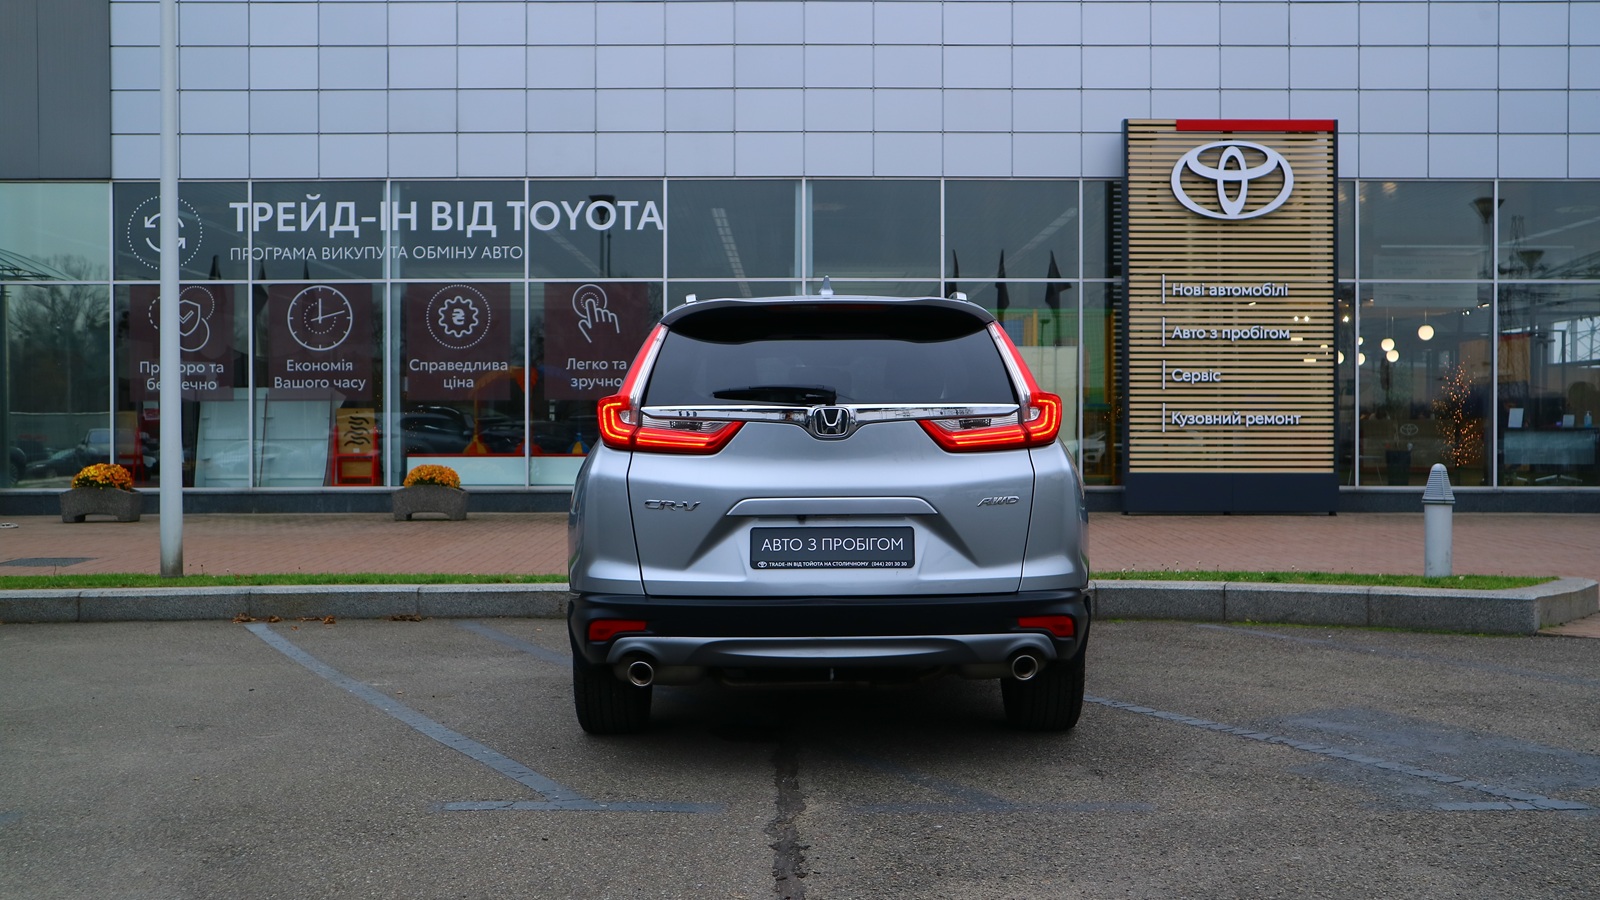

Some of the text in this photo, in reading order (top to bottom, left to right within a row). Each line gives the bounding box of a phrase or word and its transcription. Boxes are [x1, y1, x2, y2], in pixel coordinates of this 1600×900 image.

[229, 193, 665, 239] ТРЕЙД-ІН ВІД TOYOTA
[229, 244, 524, 261] ПРОГРАМА ВИКУПУ ТА ОБМІНУ АВТО
[1172, 283, 1288, 297] Нові автомобілі
[1171, 325, 1290, 343] Авто з пробігом
[139, 360, 225, 376] Проро та
[286, 359, 354, 372] Економія
[408, 358, 509, 374] Справедлива
[565, 357, 628, 371] Легко та
[443, 376, 475, 390] ціна
[570, 376, 623, 390] зручно
[1171, 368, 1222, 384] Сервіс
[273, 377, 366, 391] Вашого часу
[1171, 411, 1302, 428] Кузовний ремонт
[644, 498, 701, 512] CR-V
[977, 495, 1020, 508] AWD
[761, 538, 803, 552] АВТО
[821, 537, 905, 551] ПРОБІГОМ
